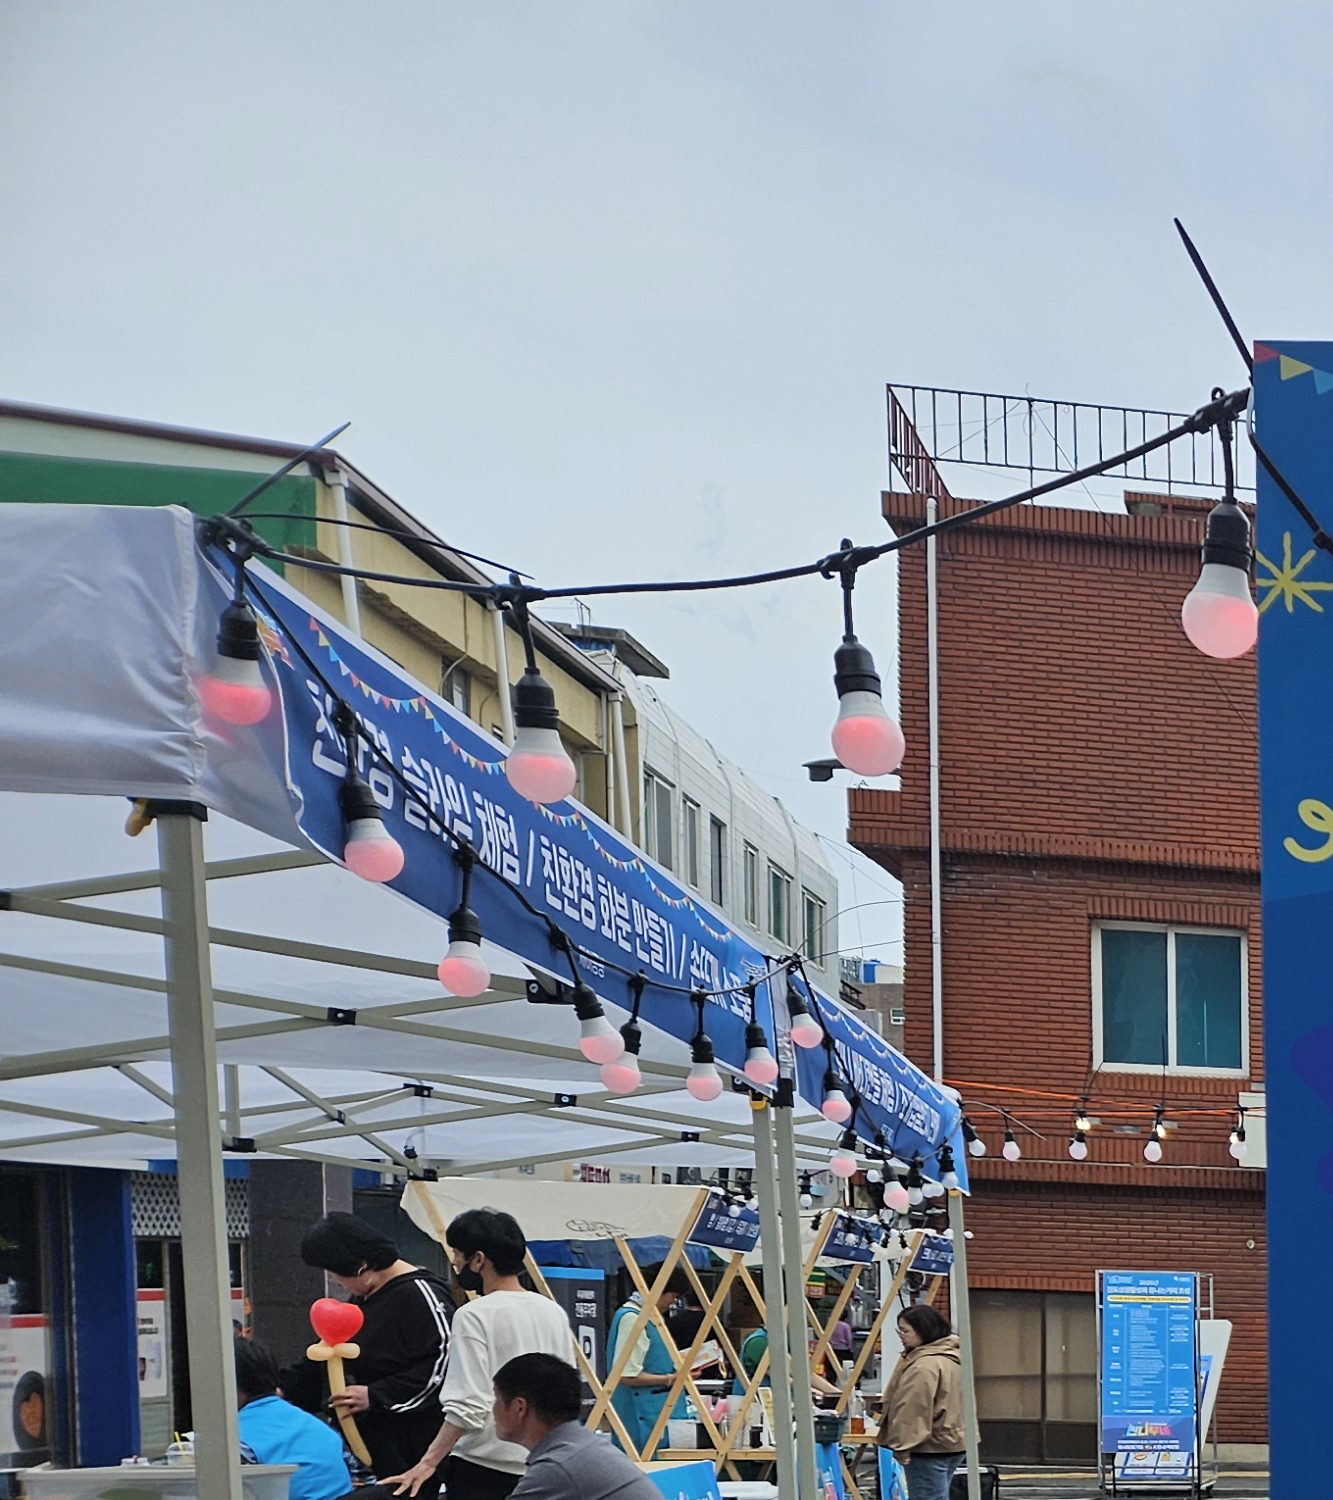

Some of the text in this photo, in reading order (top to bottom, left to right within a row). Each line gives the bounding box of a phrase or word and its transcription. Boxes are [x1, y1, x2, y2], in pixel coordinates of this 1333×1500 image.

[306, 678, 394, 810] 친경
[473, 790, 520, 884] 체험
[540, 834, 597, 931] 친환경
[597, 873, 632, 953] 화분
[631, 898, 676, 979] 만들기
